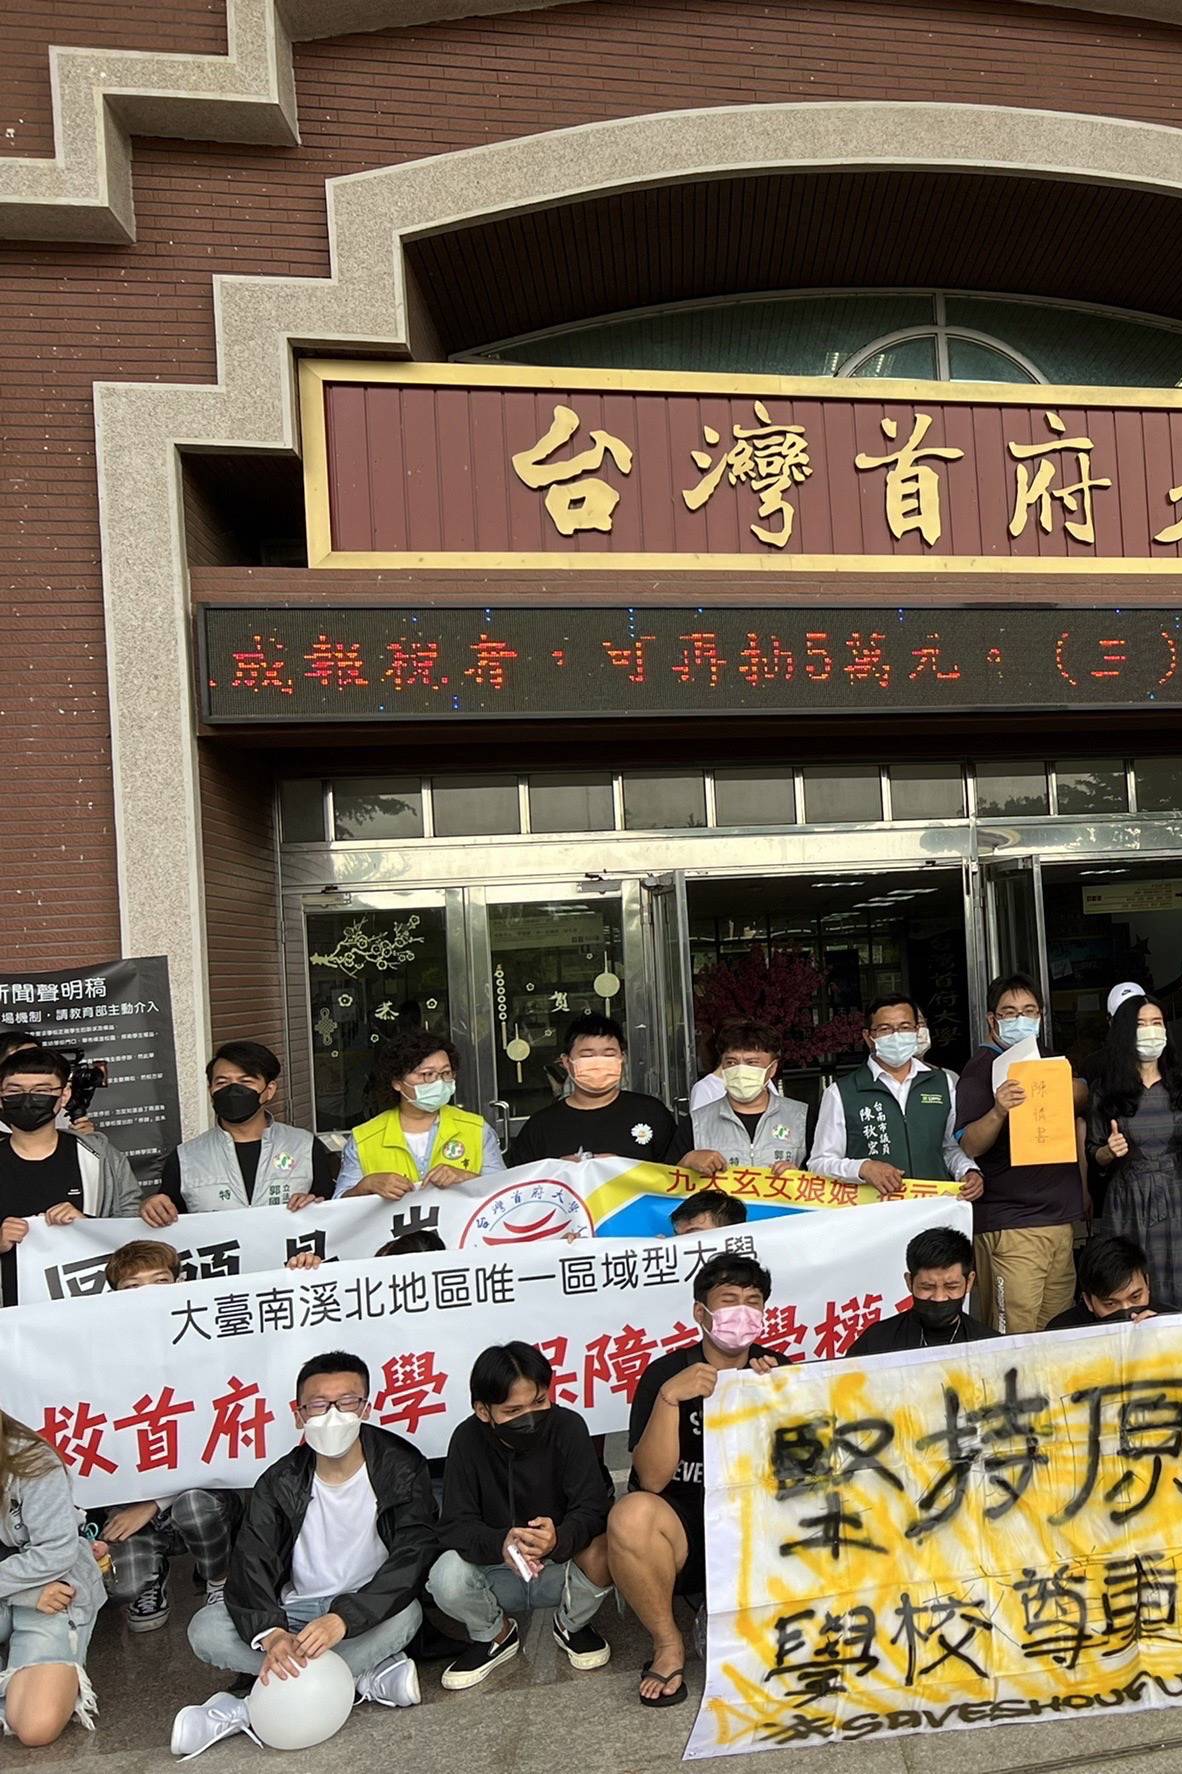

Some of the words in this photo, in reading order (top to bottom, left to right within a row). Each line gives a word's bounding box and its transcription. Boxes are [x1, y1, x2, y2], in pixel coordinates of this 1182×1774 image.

[374, 1000, 400, 1021] 恭
[548, 991, 570, 1013] 賀
[860, 1106, 879, 1156] 陳秋宏
[874, 1101, 891, 1155] 台南市議員
[666, 1168, 858, 1206] 九天玄女娘娘
[171, 1236, 757, 1345] 大臺南溪北地區唯一區域型大學
[35, 1351, 448, 1478] 救首府學
